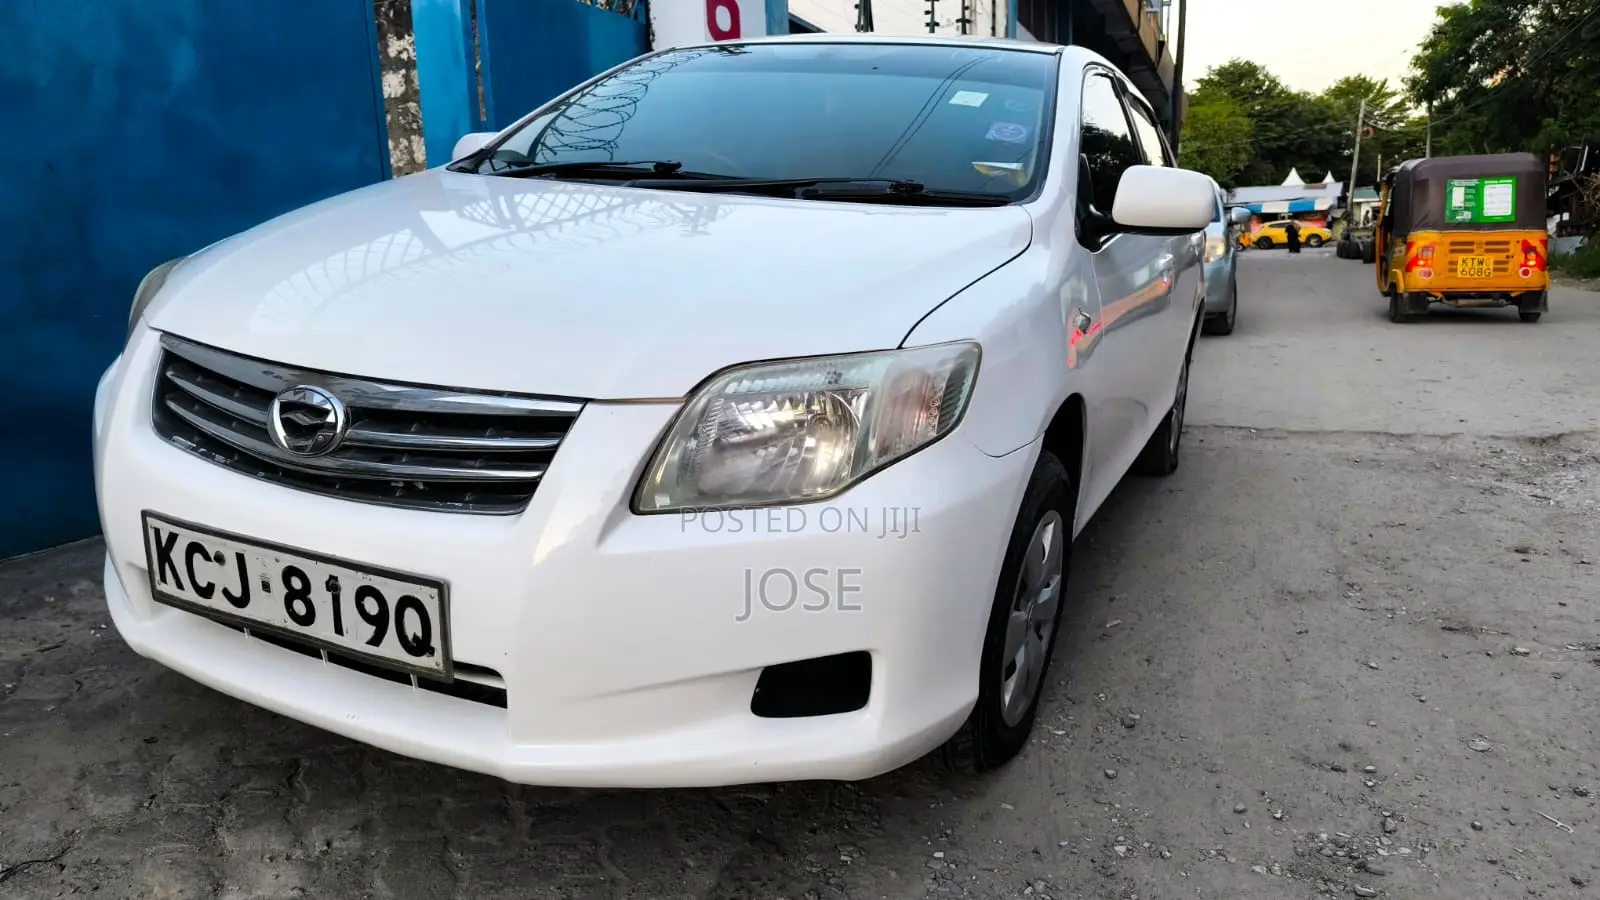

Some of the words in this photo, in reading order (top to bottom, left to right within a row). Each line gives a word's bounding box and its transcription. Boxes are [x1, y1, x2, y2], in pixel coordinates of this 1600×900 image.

[1461, 267, 1491, 277] 608G
[153, 527, 252, 609] KCJ
[281, 564, 435, 658] 819Q
